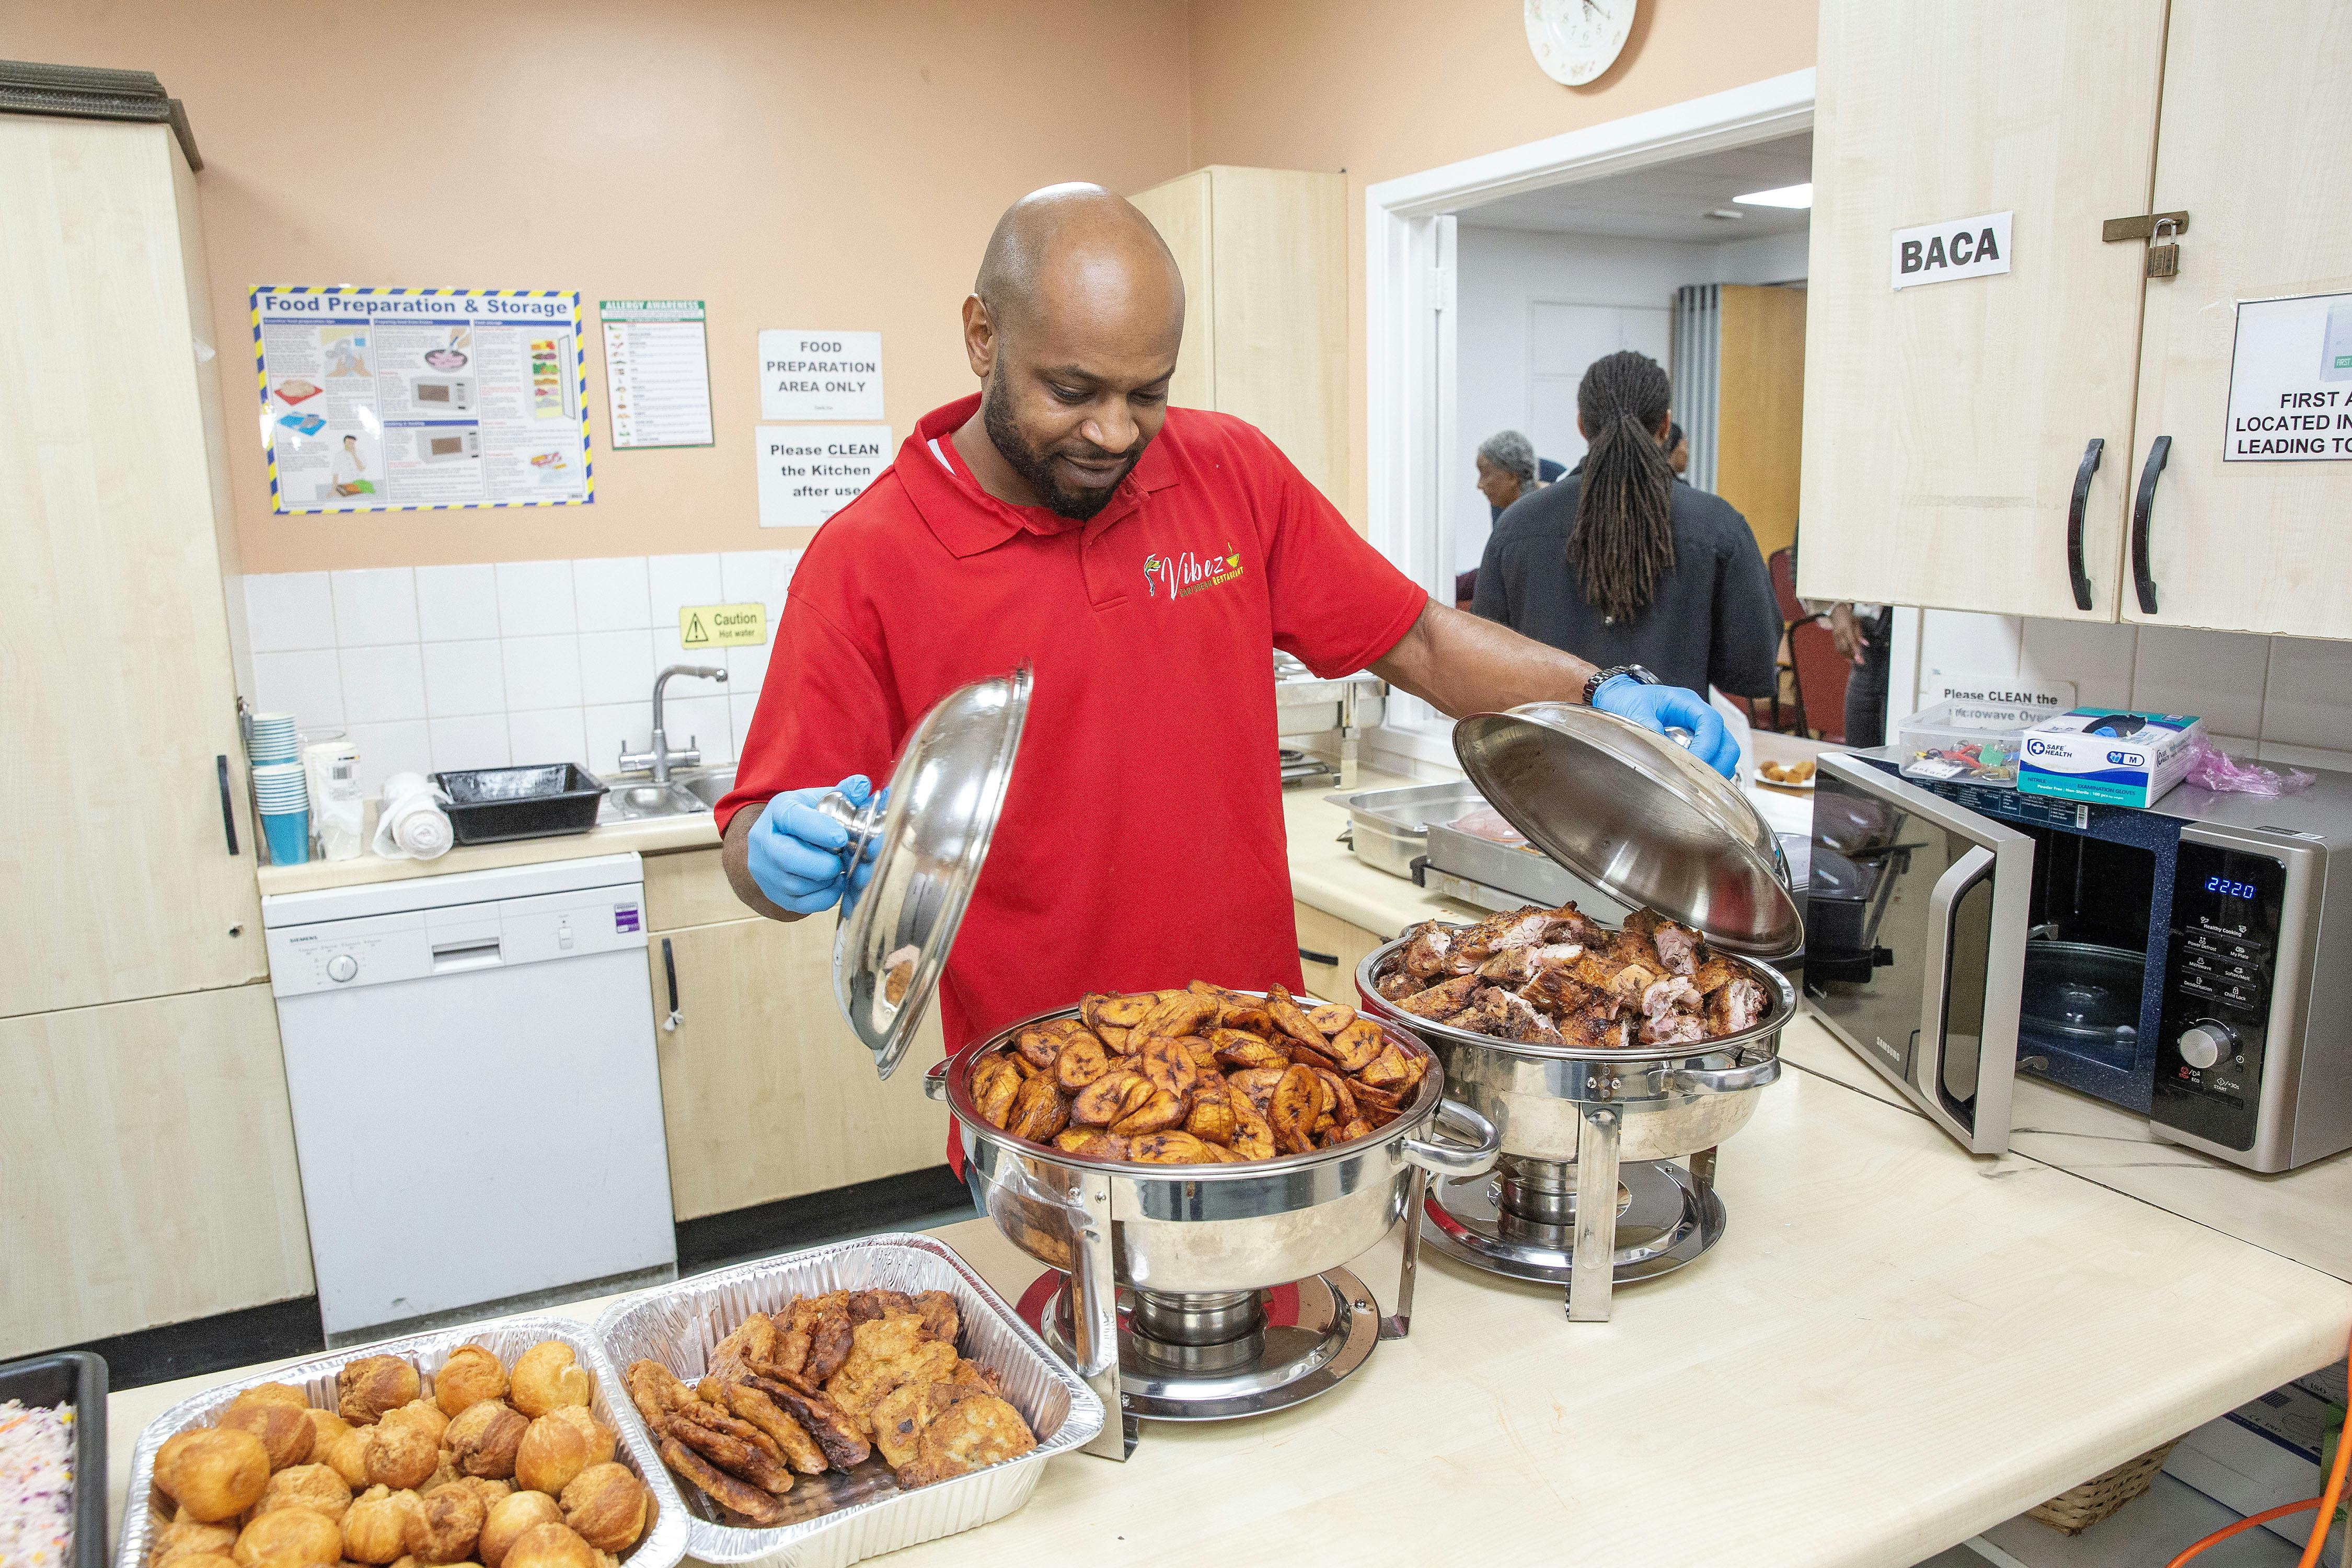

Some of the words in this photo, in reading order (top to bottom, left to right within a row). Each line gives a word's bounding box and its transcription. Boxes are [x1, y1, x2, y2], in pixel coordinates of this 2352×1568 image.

[1900, 227, 2000, 274] BACA
[265, 296, 319, 312] Food
[328, 297, 455, 315] Preparation
[465, 298, 478, 313] &
[487, 298, 568, 317] Storage
[800, 341, 842, 353] FOOD
[766, 361, 875, 373] PREPARATION
[779, 381, 819, 393] AREA
[825, 382, 866, 393] ONLY
[2280, 392, 2339, 408] FIRST
[2236, 414, 2330, 432] LOCATED
[770, 444, 822, 456] Please
[828, 444, 880, 456] CLEAN
[2238, 438, 2325, 454] LEADING
[781, 465, 806, 476] the
[812, 465, 870, 476] Kitchen
[793, 485, 829, 496] after
[835, 487, 861, 496] use
[1160, 551, 1224, 601] Vibez
[714, 613, 757, 626] Caution
[1944, 689, 1984, 700] Please
[1988, 691, 2032, 703] CLEAN
[2036, 694, 2058, 705] the
[2045, 750, 2072, 758] HEALTH
[2077, 783, 2114, 793] EXAMINATION
[2208, 877, 2254, 898] 2220
[2204, 924, 2222, 932] Healthy
[2222, 928, 2242, 937] Cooking
[2189, 961, 2211, 971] Microwave
[2225, 971, 2250, 981] Soften/Melt
[2184, 981, 2212, 991] Deodorisation
[1876, 1036, 1900, 1062] SAMSUNG
